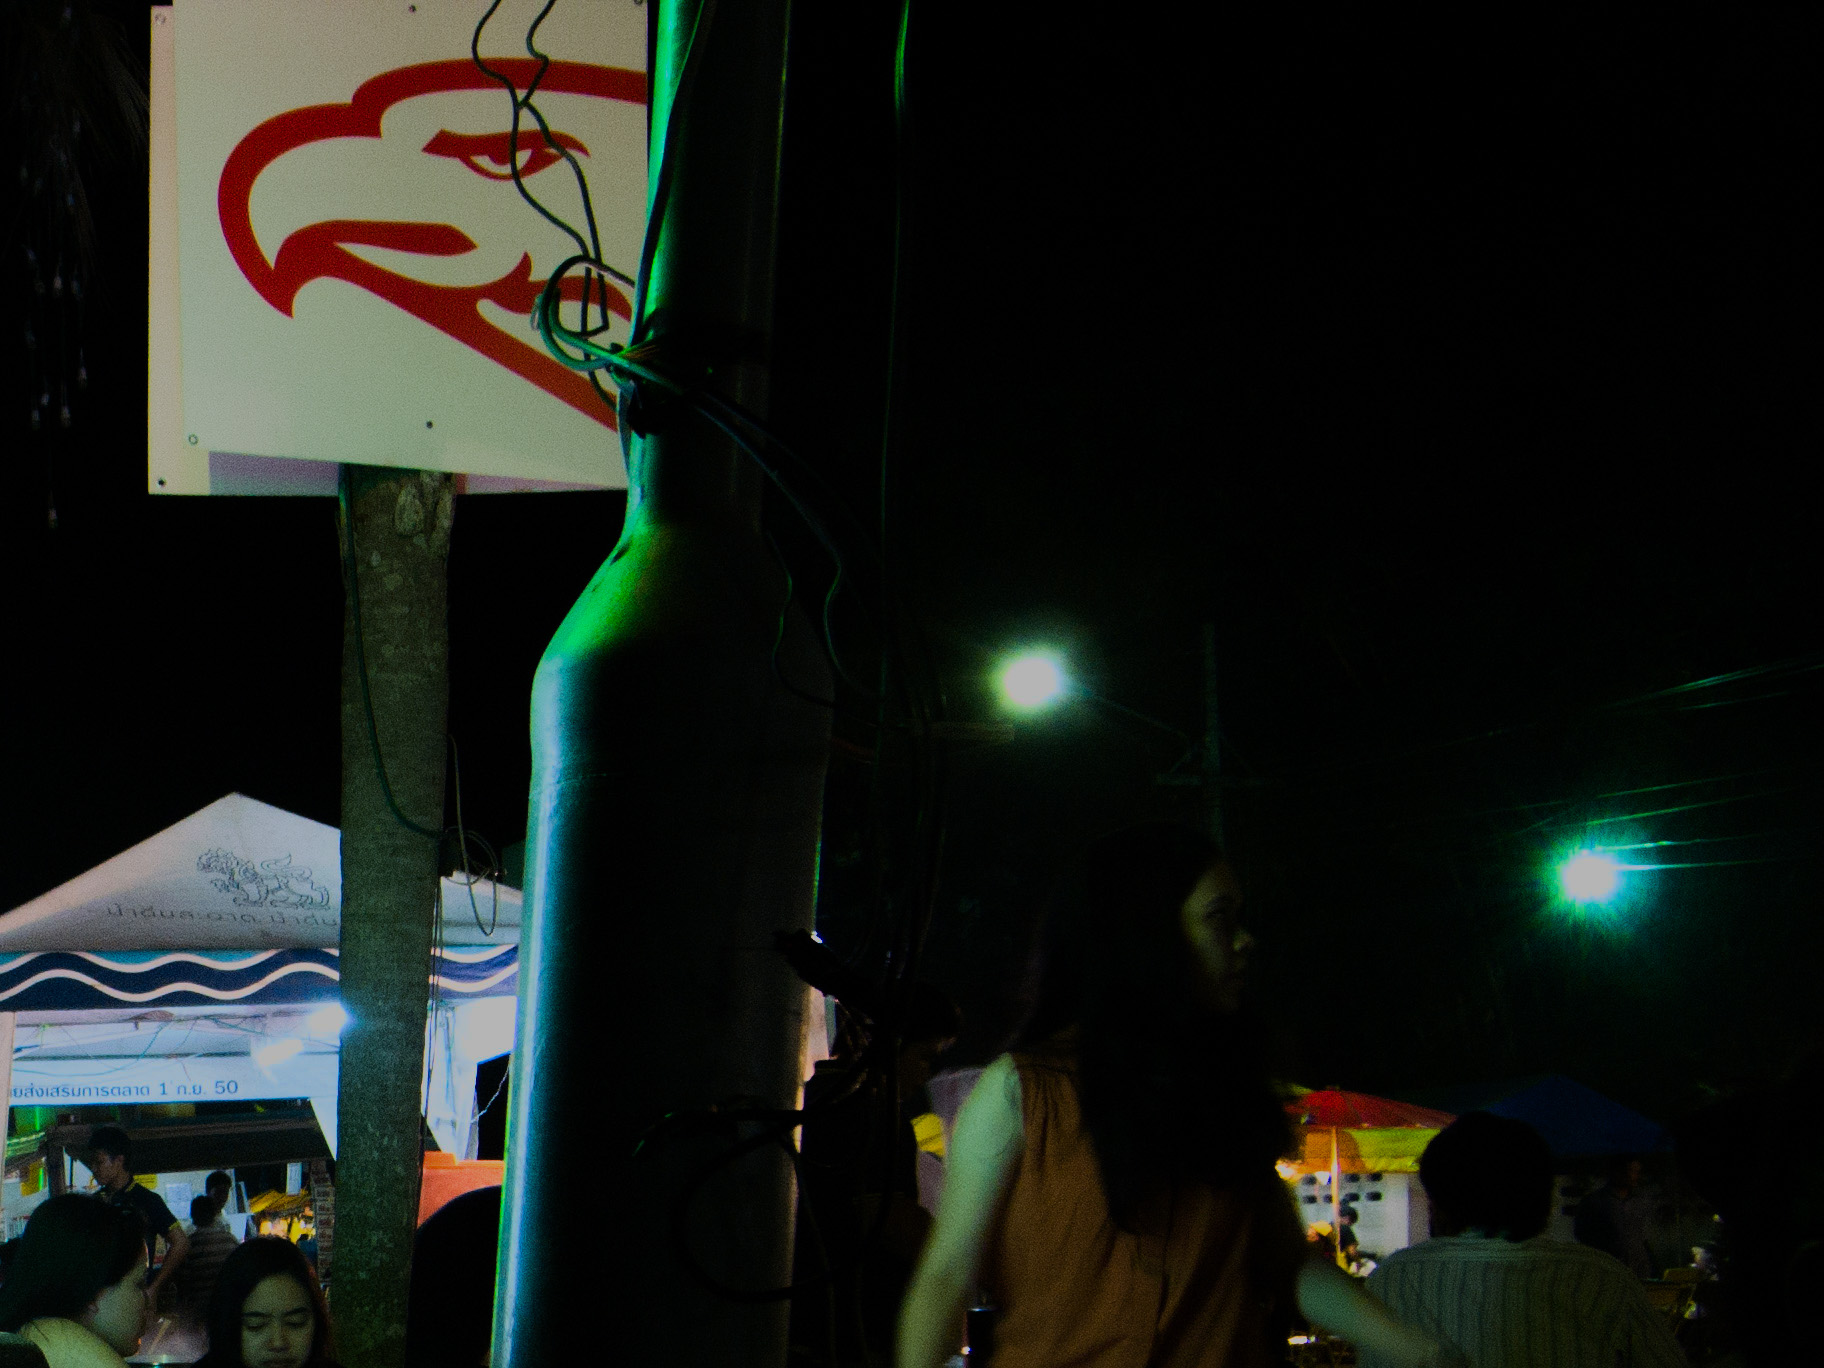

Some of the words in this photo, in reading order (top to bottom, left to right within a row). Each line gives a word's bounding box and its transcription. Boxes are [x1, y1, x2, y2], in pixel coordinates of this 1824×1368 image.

[10, 1081, 151, 1099] ยส่งเสริมการตลาด
[159, 1081, 169, 1097] 1
[215, 1079, 239, 1095] 50
